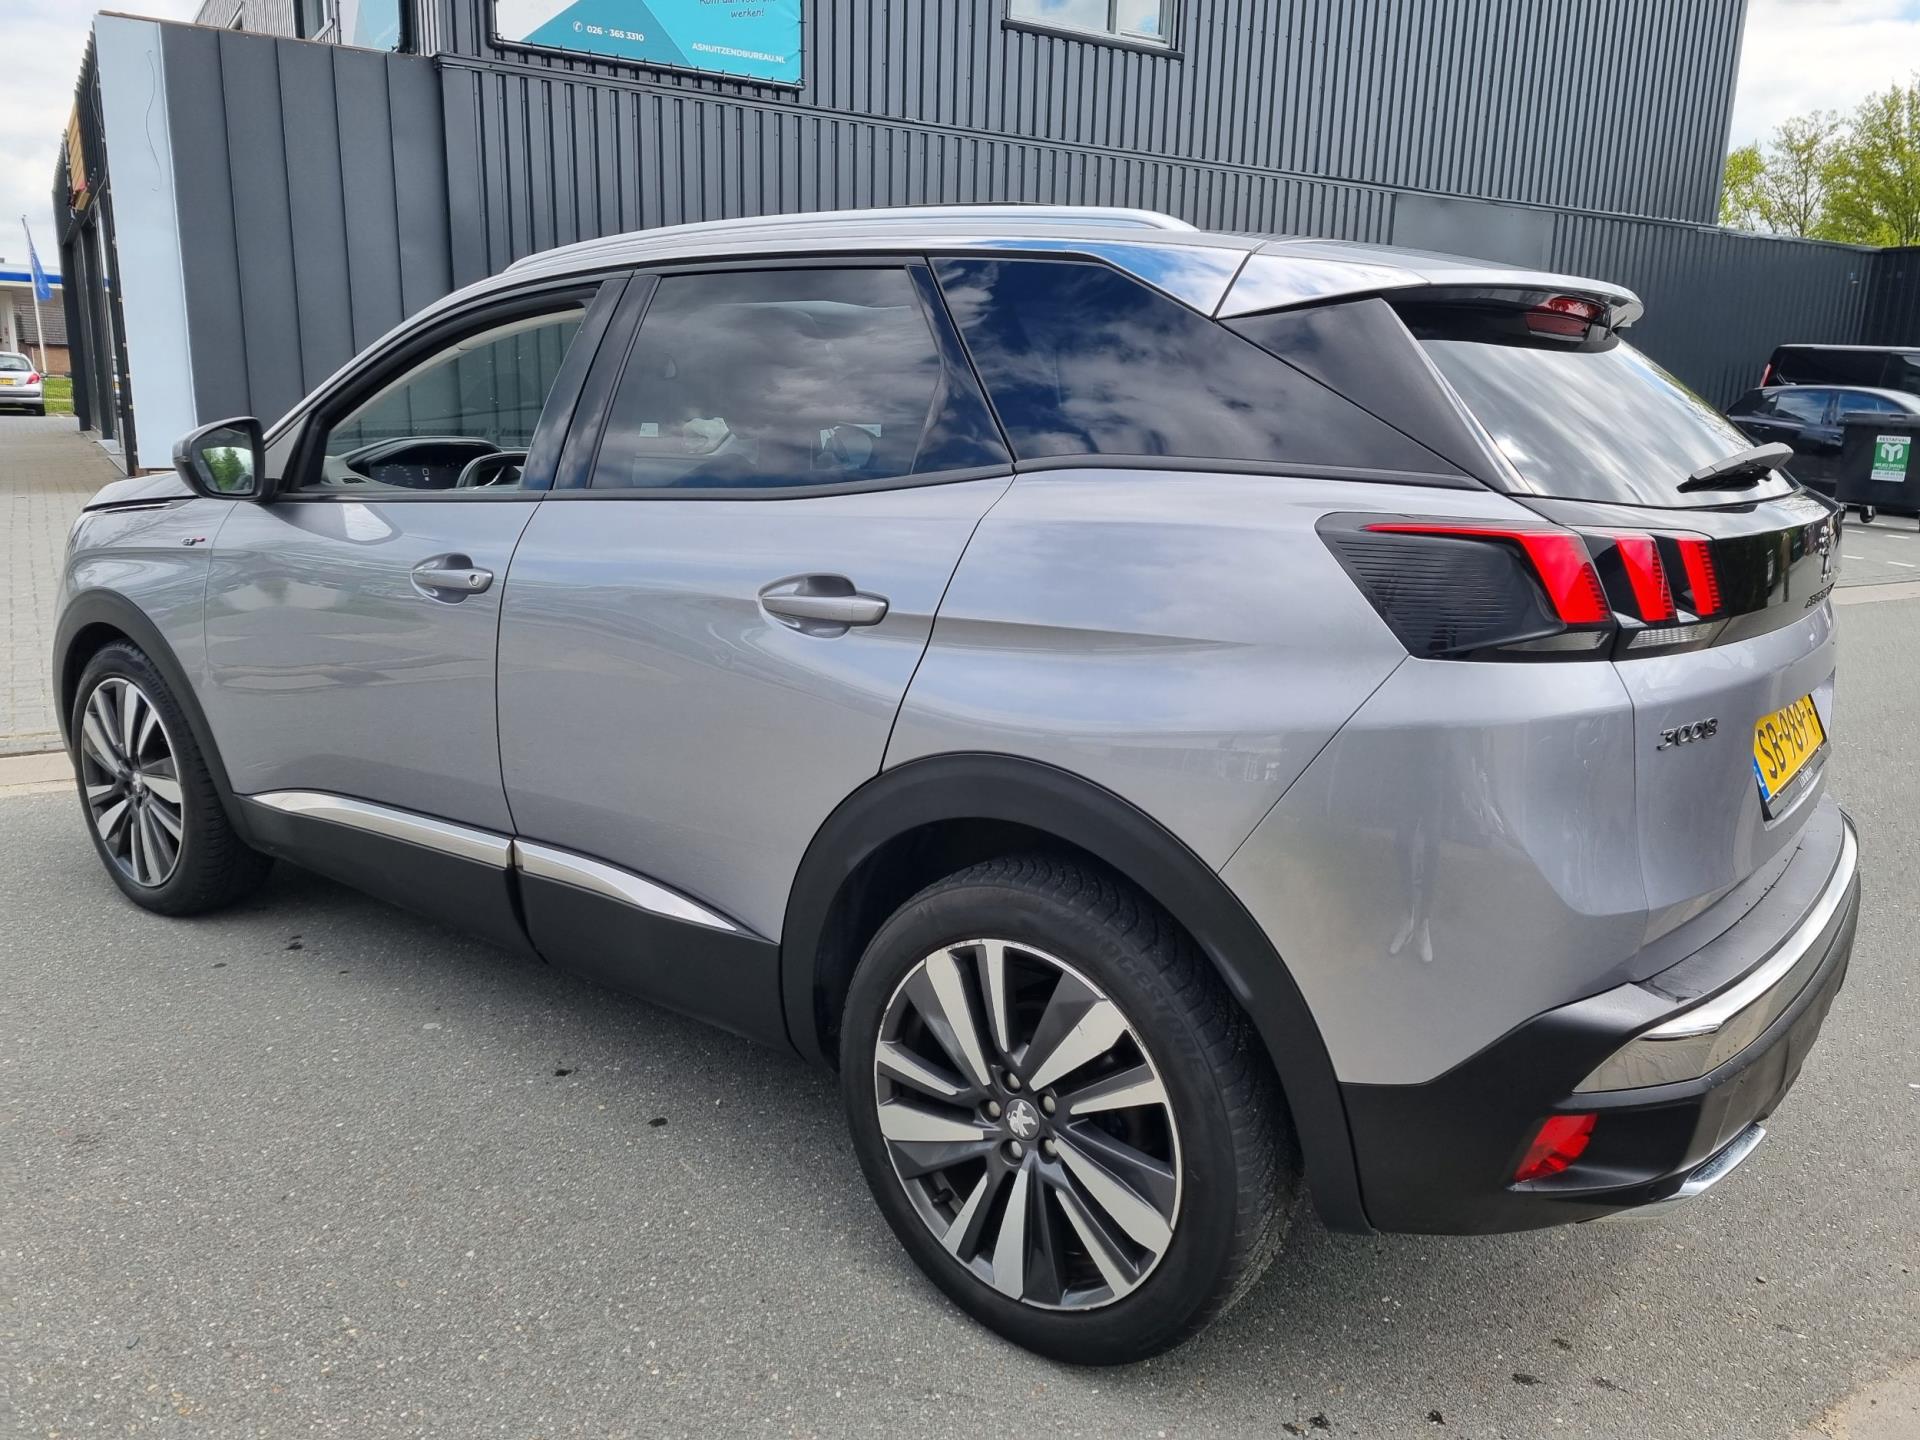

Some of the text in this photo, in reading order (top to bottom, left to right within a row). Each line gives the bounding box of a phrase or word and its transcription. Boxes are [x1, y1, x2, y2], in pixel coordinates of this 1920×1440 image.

[731, 8, 765, 18] werken!
[586, 25, 603, 36] 026
[608, 28, 625, 39] 365
[625, 31, 645, 42] 3310
[692, 42, 786, 64] ASNUITZENDBUREAU.NL
[1656, 717, 1719, 751] 3008
